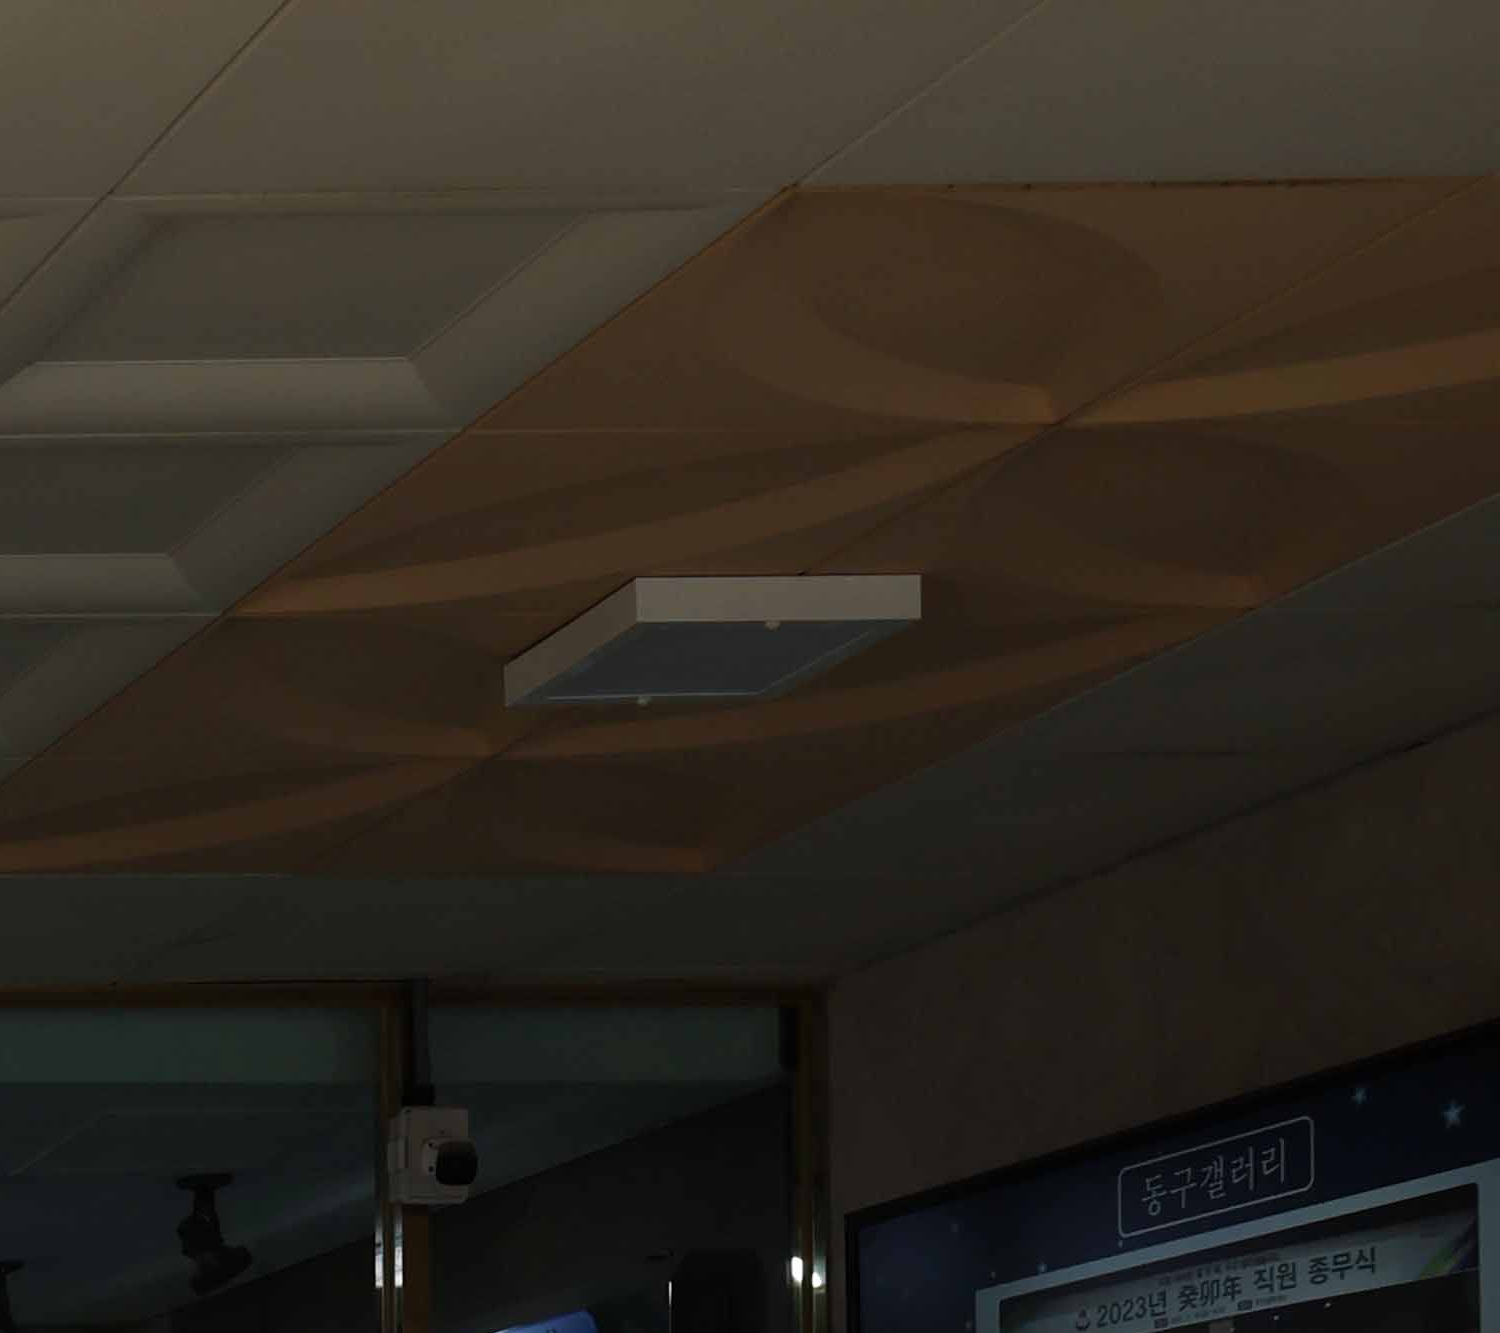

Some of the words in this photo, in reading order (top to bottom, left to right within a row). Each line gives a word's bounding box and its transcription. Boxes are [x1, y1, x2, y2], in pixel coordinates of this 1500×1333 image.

[1141, 1136, 1286, 1217] 동구갤러리
[1097, 1290, 1168, 1329] 2023년
[1253, 1262, 1299, 1294] 직원
[1308, 1246, 1378, 1286] 종무식
